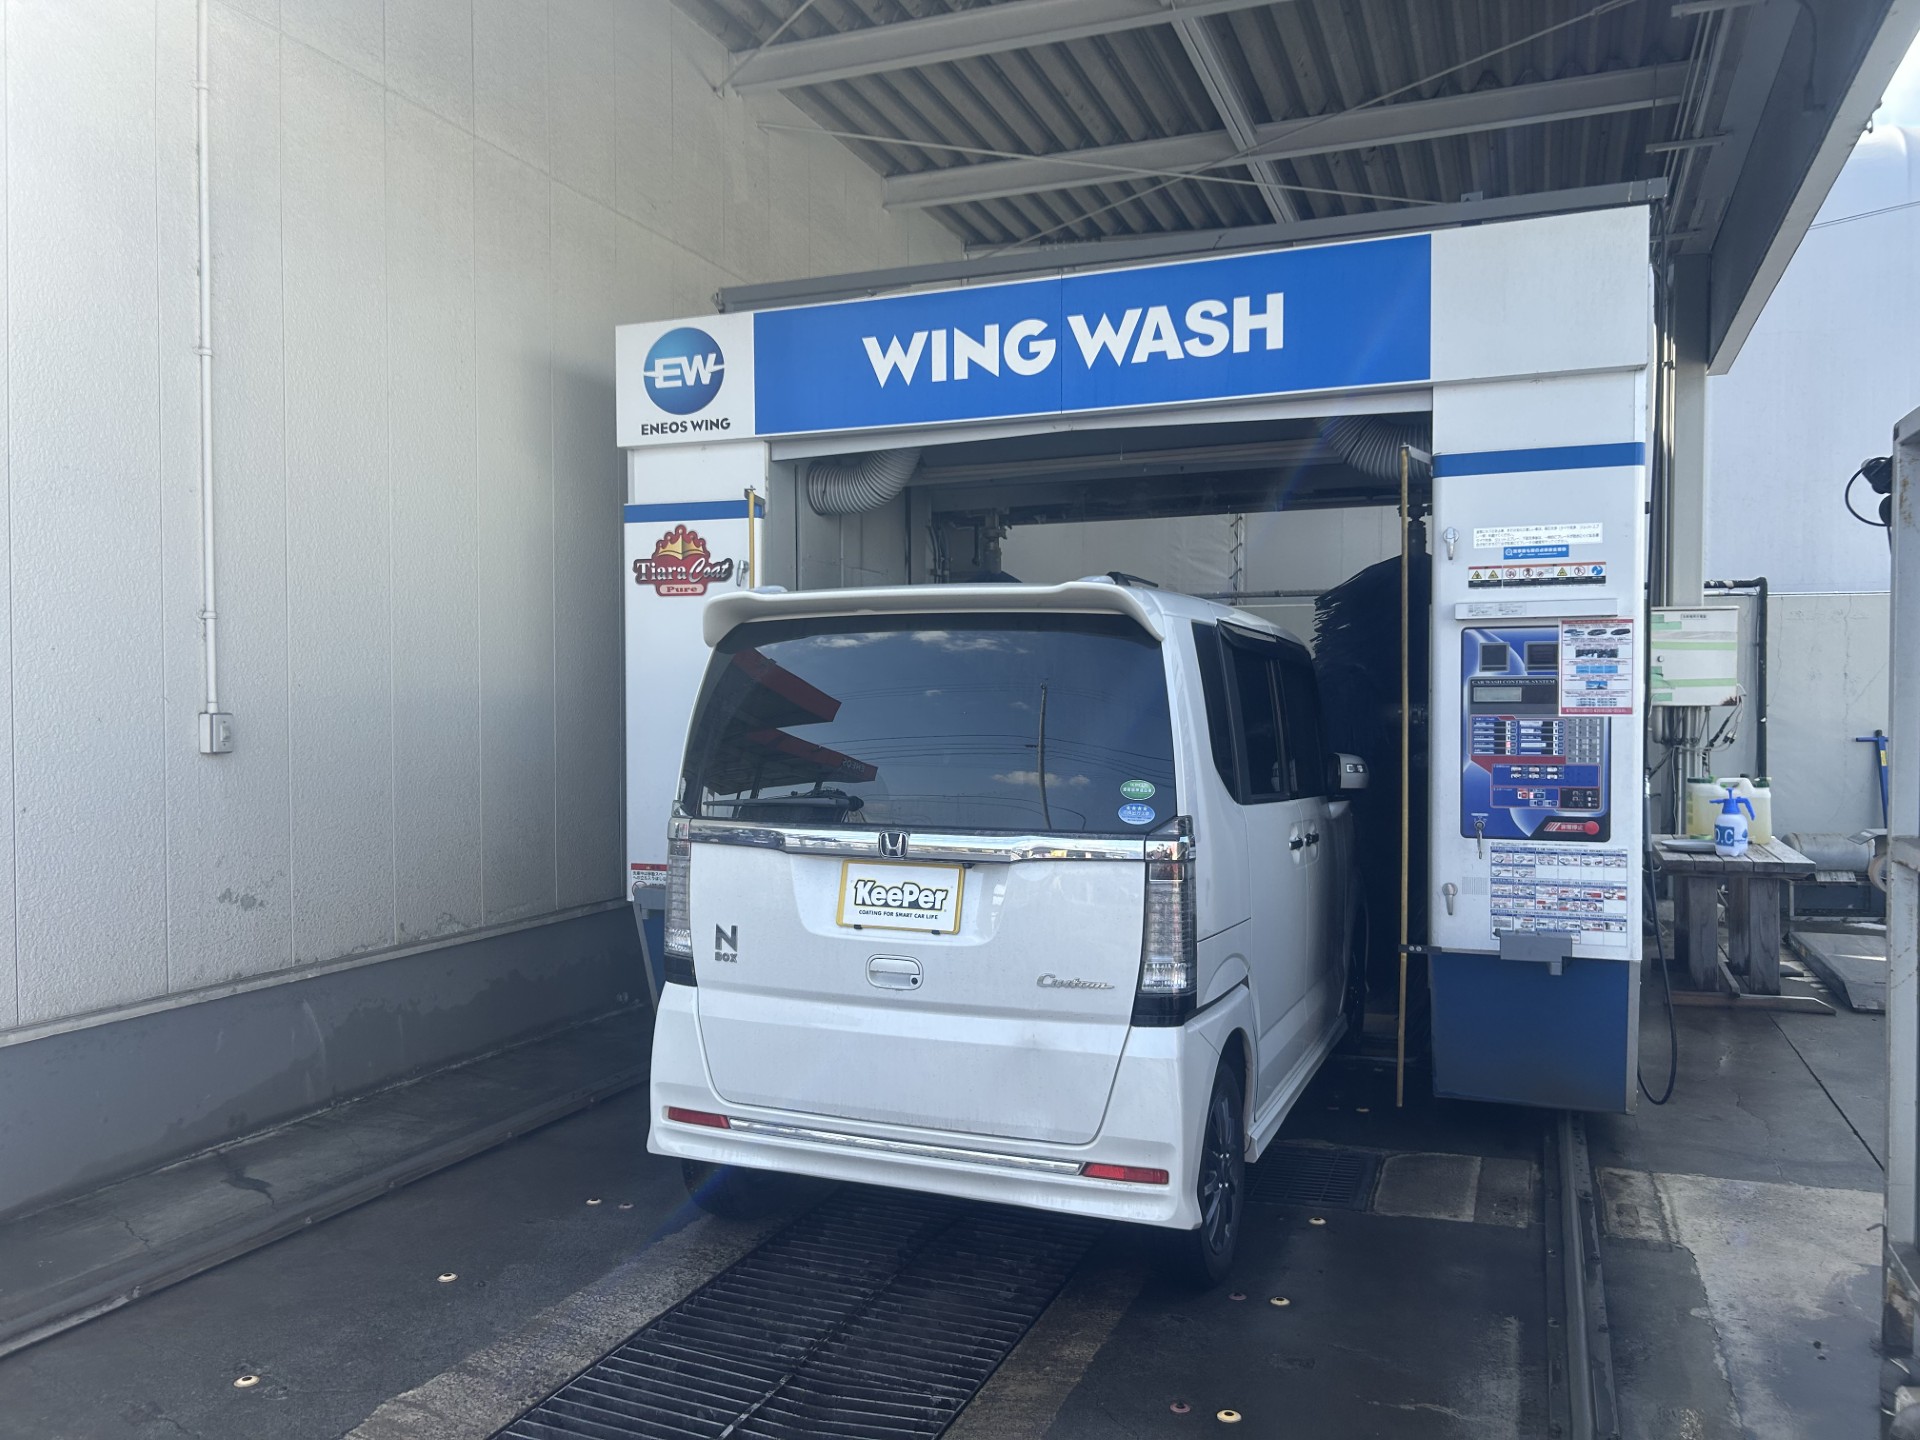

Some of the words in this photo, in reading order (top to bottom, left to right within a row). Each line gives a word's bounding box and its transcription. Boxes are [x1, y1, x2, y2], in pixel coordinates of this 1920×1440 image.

[861, 317, 1057, 389] WING
[1066, 291, 1285, 370] WASH
[650, 352, 720, 390] EW
[641, 419, 688, 436] ENEOS
[690, 417, 731, 433] WING
[636, 561, 687, 581] Tiara
[687, 557, 730, 583] Coat
[666, 585, 698, 593] Pure
[853, 879, 949, 911] KeePer
[715, 923, 738, 952] N
[714, 951, 738, 963] BOX
